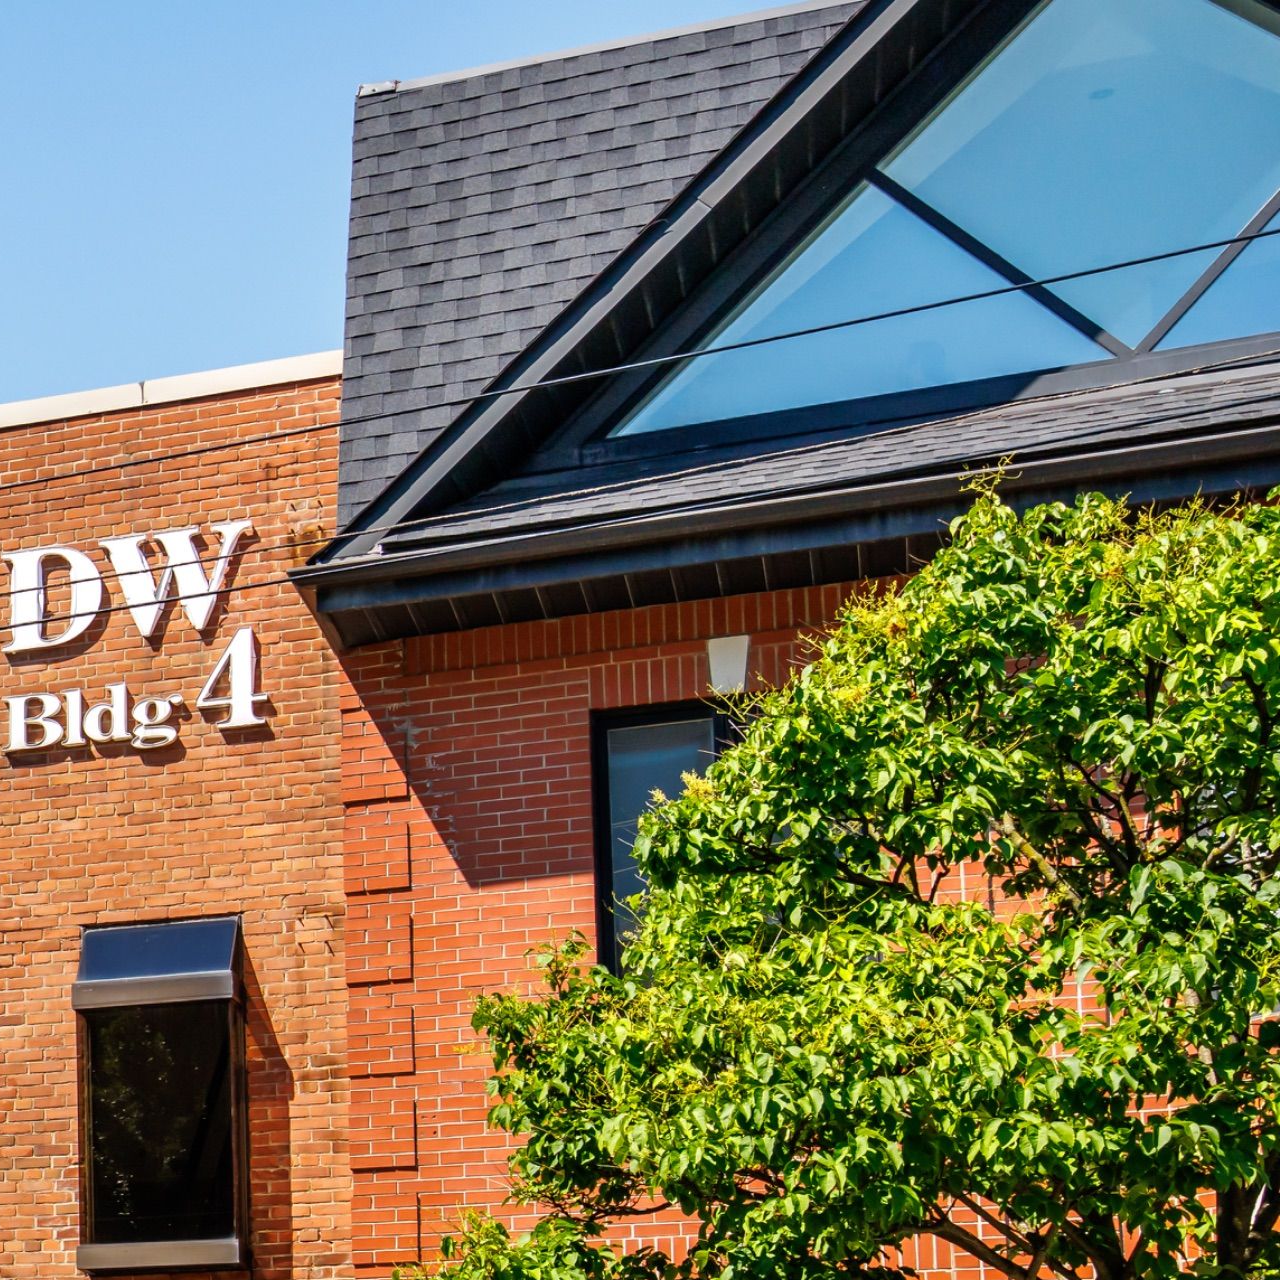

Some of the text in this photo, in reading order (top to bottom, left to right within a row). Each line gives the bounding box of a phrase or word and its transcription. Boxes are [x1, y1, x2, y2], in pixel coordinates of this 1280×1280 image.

[1, 520, 253, 656] DW
[2, 626, 268, 755] Bldg 4
